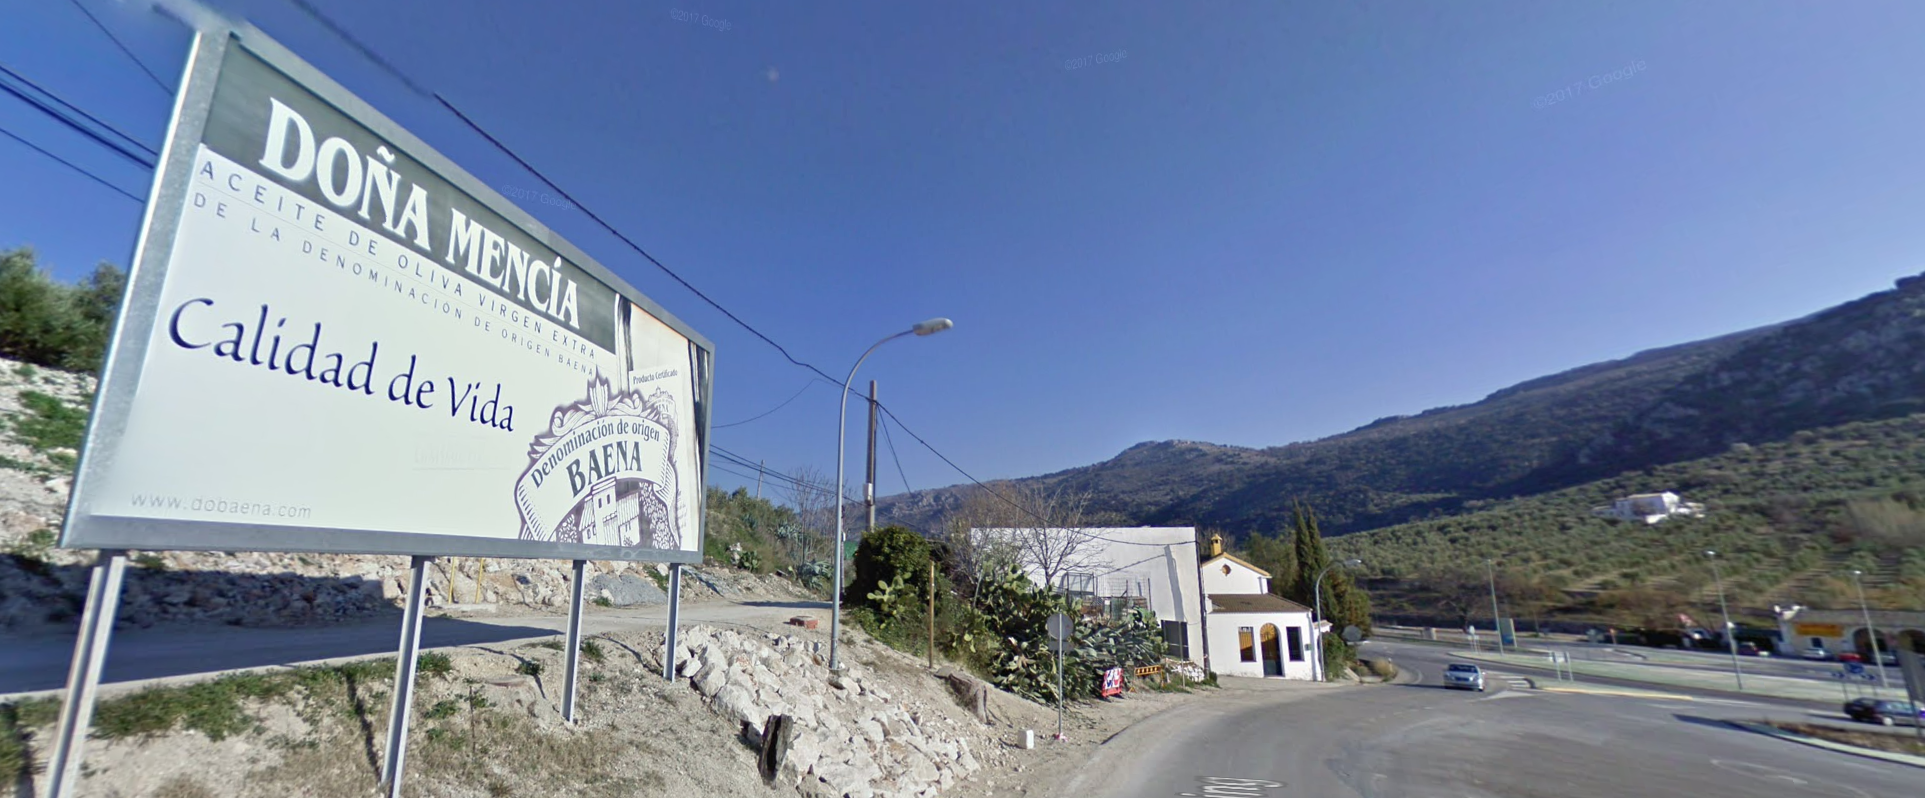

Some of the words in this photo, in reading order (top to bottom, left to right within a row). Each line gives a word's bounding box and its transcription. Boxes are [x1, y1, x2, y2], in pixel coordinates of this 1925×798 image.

[200, 160, 326, 232] ACEITE
[349, 230, 378, 256] DE
[397, 254, 463, 297] OLIVA
[479, 293, 542, 334] VIRGEN
[552, 330, 596, 360] EXTRA
[258, 96, 431, 251] DOÑA
[445, 208, 580, 329] MENCÍA
[194, 192, 227, 219] DE
[251, 217, 280, 242] LA
[474, 316, 491, 332] DE
[501, 328, 550, 358] ORIGEN
[558, 354, 594, 377] BAENA
[168, 297, 379, 396] Calidad
[387, 354, 435, 409] de
[447, 376, 515, 432] Vida
[633, 374, 655, 385] Producto
[655, 368, 678, 380] Certificado
[530, 418, 614, 489] Denominación
[617, 418, 629, 435] de
[632, 420, 660, 442] origen
[566, 440, 643, 498] BAENA
[130, 492, 312, 519] www.dobaena.com
